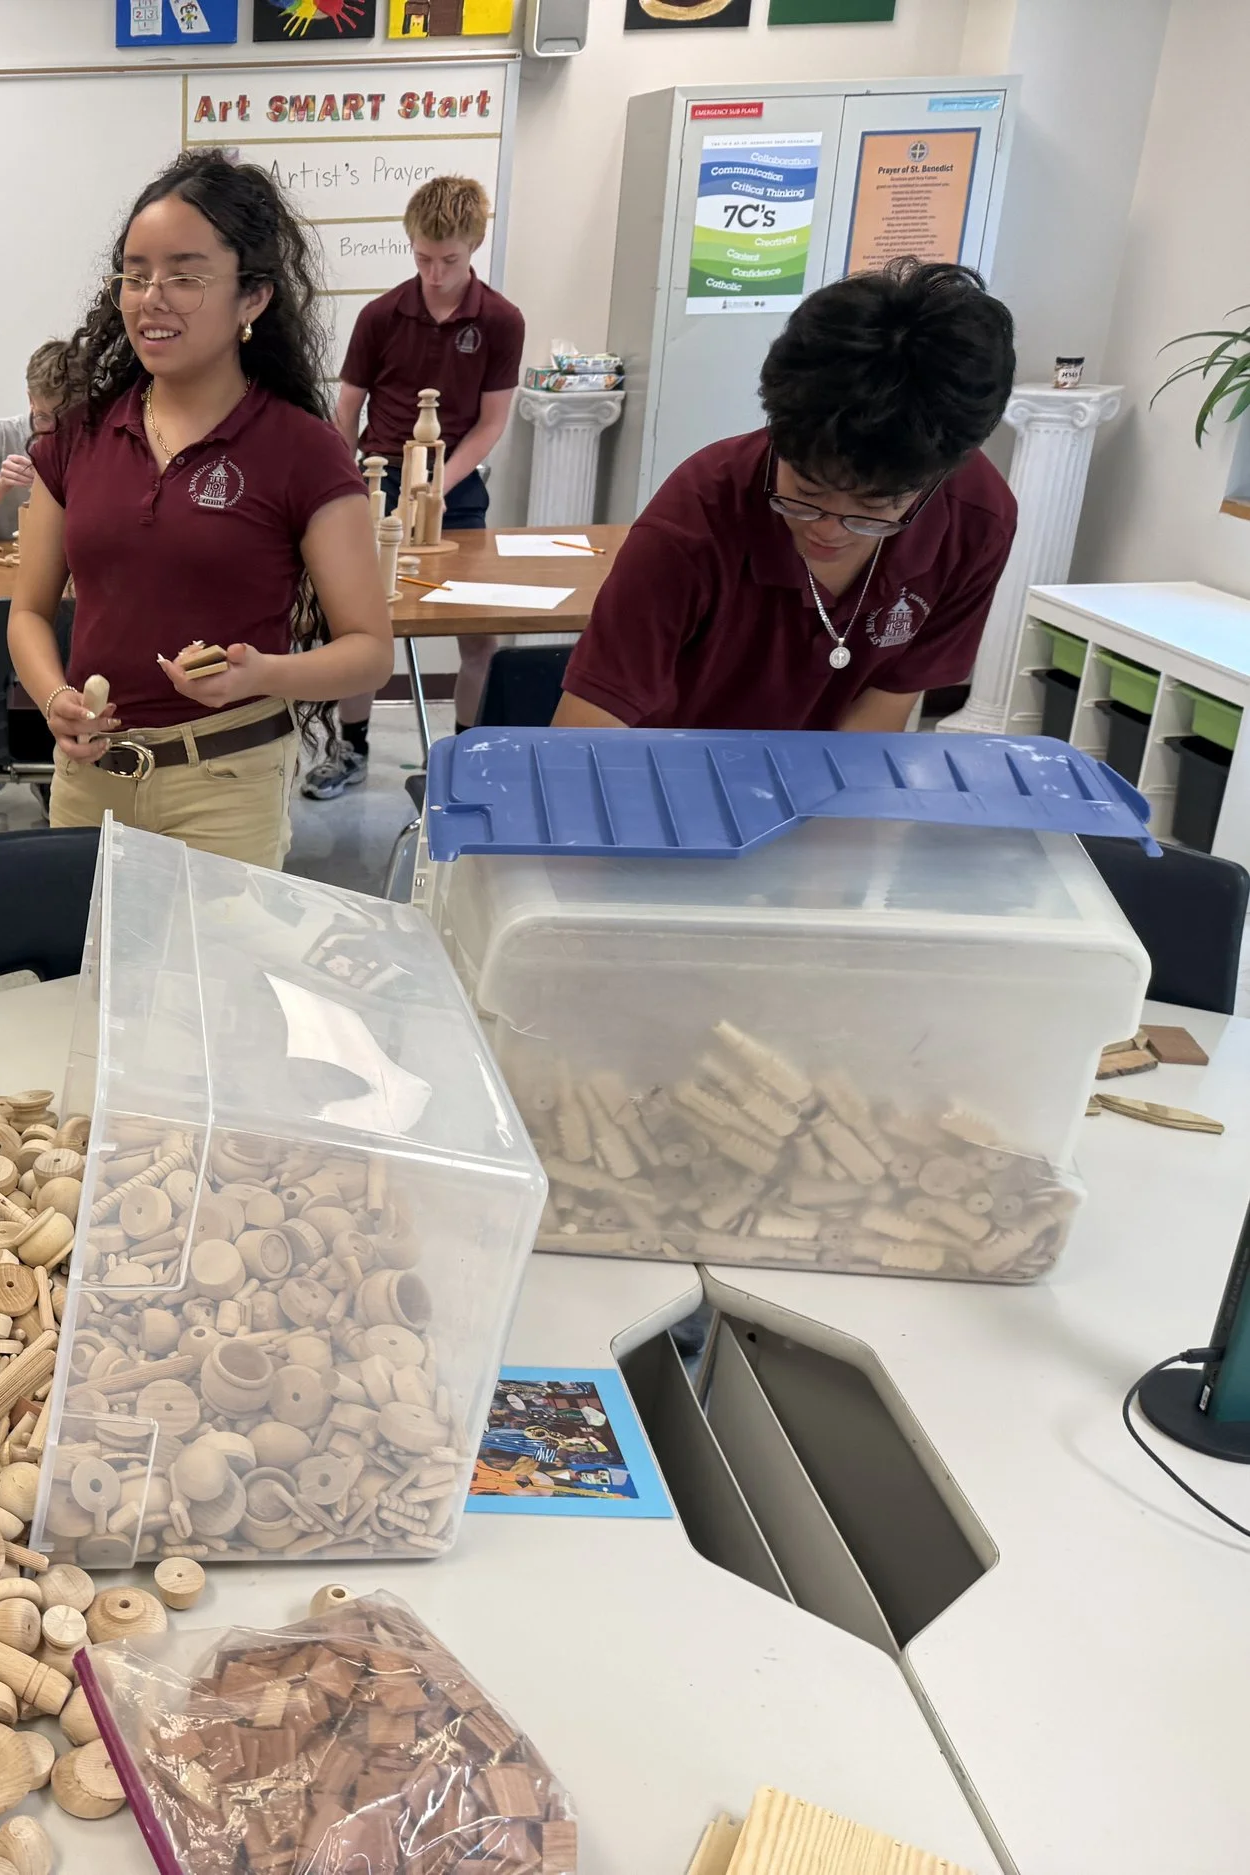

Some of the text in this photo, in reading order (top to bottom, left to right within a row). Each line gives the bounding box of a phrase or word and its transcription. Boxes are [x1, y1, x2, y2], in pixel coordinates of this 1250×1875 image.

[193, 89, 491, 123] Art SMART Start
[695, 107, 728, 117] EMERGENCY
[741, 106, 759, 115] PLANS
[750, 151, 811, 166] Collaboration
[268, 156, 436, 190] Artist's Prayer
[710, 166, 784, 182] Communication
[877, 166, 900, 175] Prayer
[901, 165, 910, 174] of
[921, 164, 954, 173] Benedict
[731, 181, 805, 199] Critical Thinking
[723, 203, 776, 229] 7C's
[339, 236, 414, 257] Breathin
[754, 234, 798, 247] Creativity
[731, 267, 782, 278] Confidence
[705, 277, 743, 291] Catholic
